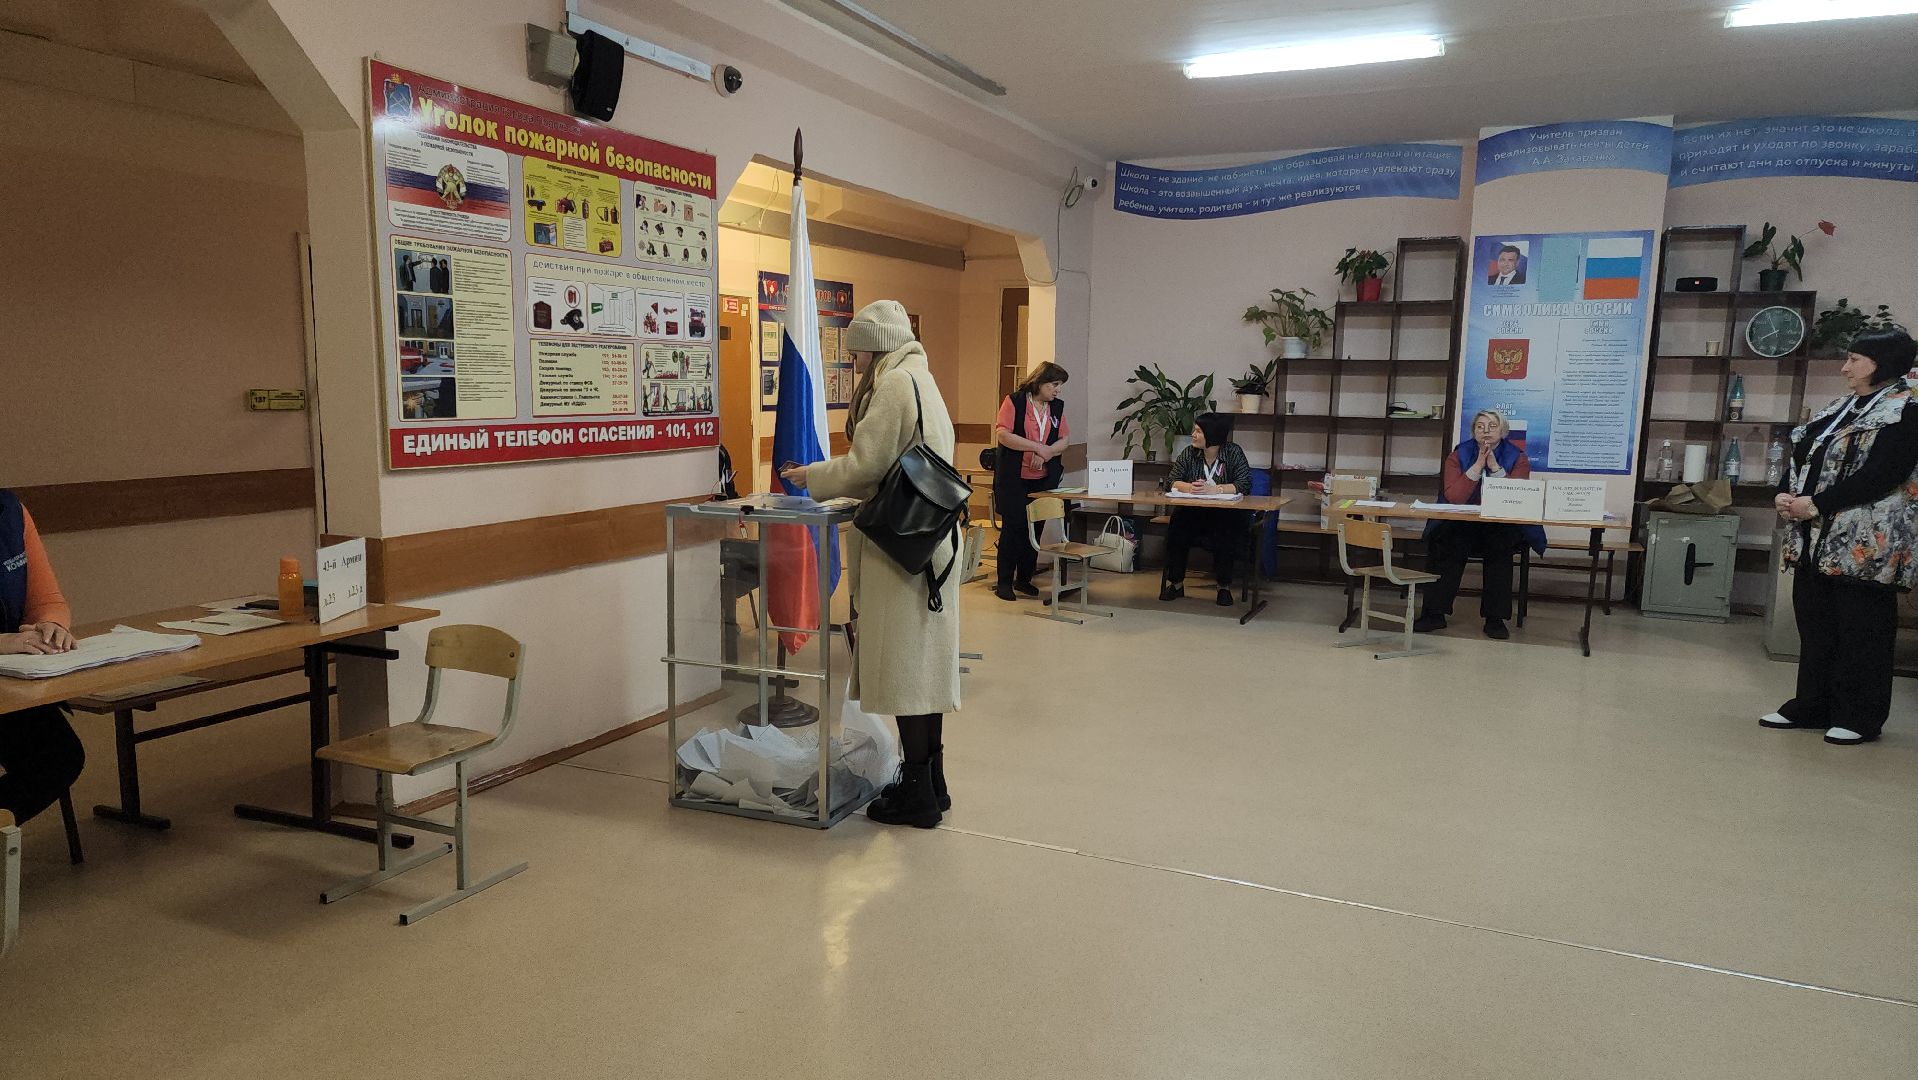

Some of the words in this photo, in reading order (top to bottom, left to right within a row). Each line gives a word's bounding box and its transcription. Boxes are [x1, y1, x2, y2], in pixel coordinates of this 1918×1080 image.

[1529, 131, 1574, 142] Учитель
[1577, 129, 1623, 138] призван
[1718, 130, 1732, 139] их
[1764, 124, 1809, 134] значит
[1812, 124, 1836, 133] это
[1838, 125, 1854, 133] не
[418, 97, 499, 141] Уголок
[504, 125, 600, 165] пожарной
[605, 145, 713, 190] безопасности
[1494, 141, 1578, 162] реализовывать
[1679, 144, 1739, 162] приходят
[1742, 143, 1750, 151] и
[1753, 140, 1799, 153] уходят
[1801, 140, 1818, 149] по
[1120, 167, 1150, 181] Школа
[1158, 175, 1170, 183] не
[1272, 162, 1285, 172] не
[1285, 153, 1345, 169] образцовая
[1347, 150, 1402, 161] наглядная
[1680, 169, 1688, 177] и
[1691, 161, 1745, 175] считают
[1747, 159, 1773, 168] дни
[1775, 158, 1792, 167] до
[1795, 158, 1848, 169] отпуска
[1851, 160, 1860, 168] и
[1863, 160, 1914, 173] минуты
[1120, 181, 1149, 196] Школа
[1158, 190, 1174, 198] это
[1175, 183, 1240, 198] возвышенный
[1326, 165, 1370, 178] которые
[1372, 164, 1423, 176] увлекают
[1425, 166, 1456, 178] сразу
[1199, 200, 1243, 215] родителя
[1261, 197, 1275, 207] тут
[1278, 193, 1292, 202] же
[1295, 184, 1361, 200] реализуются
[532, 260, 574, 273] Действия
[576, 266, 592, 277] при
[593, 268, 624, 280] пожаре
[632, 272, 685, 286] общественном
[1483, 303, 1570, 317] СИМВОЛИКА
[1574, 302, 1633, 316] РОССИИ
[1496, 327, 1524, 335] РОССИИ
[402, 429, 489, 457] ЕДИНЫЙ
[493, 429, 574, 448] ТЕЛЕФОН
[578, 424, 655, 442] СПАСЕНИЯ
[665, 422, 691, 439] 101,
[693, 421, 714, 437] 112
[322, 559, 337, 572] 43-й
[341, 553, 362, 568] Армии
